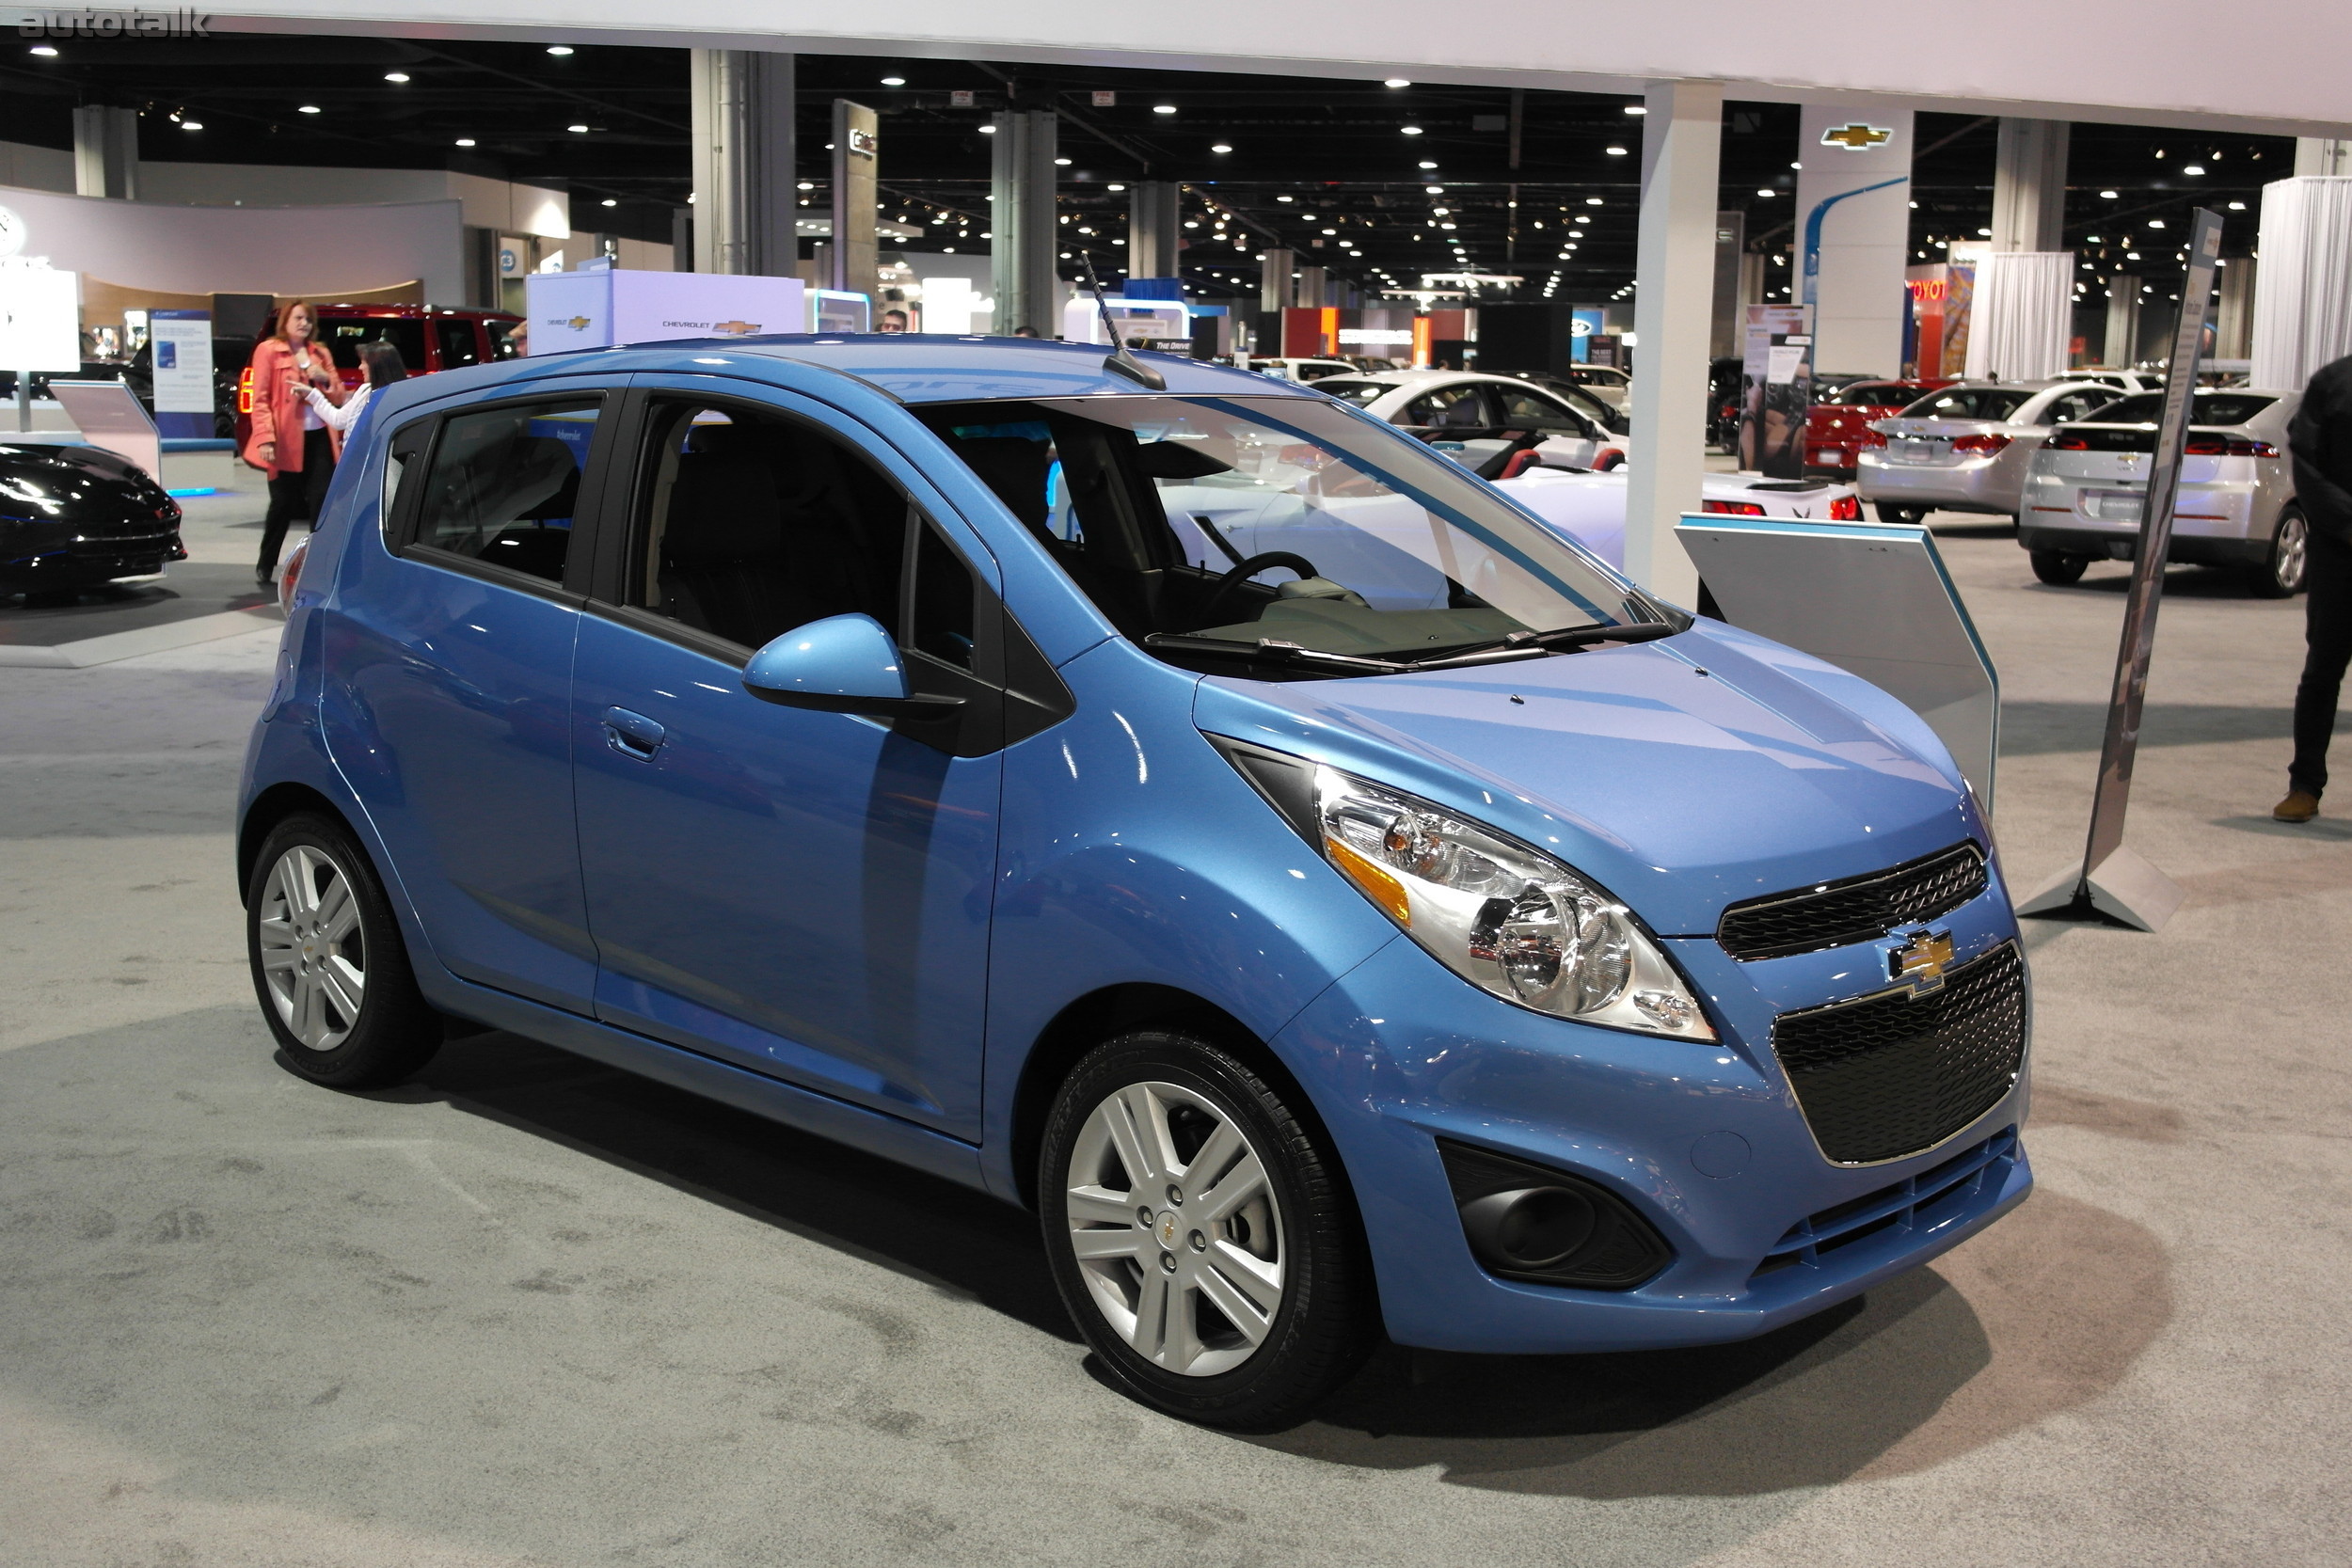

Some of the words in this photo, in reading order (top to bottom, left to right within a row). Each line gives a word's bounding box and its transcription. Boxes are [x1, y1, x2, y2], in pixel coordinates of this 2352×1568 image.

[662, 321, 710, 329] CHEVROLET
[1156, 341, 1169, 350] THE
[1170, 341, 1190, 350] DRIVE
